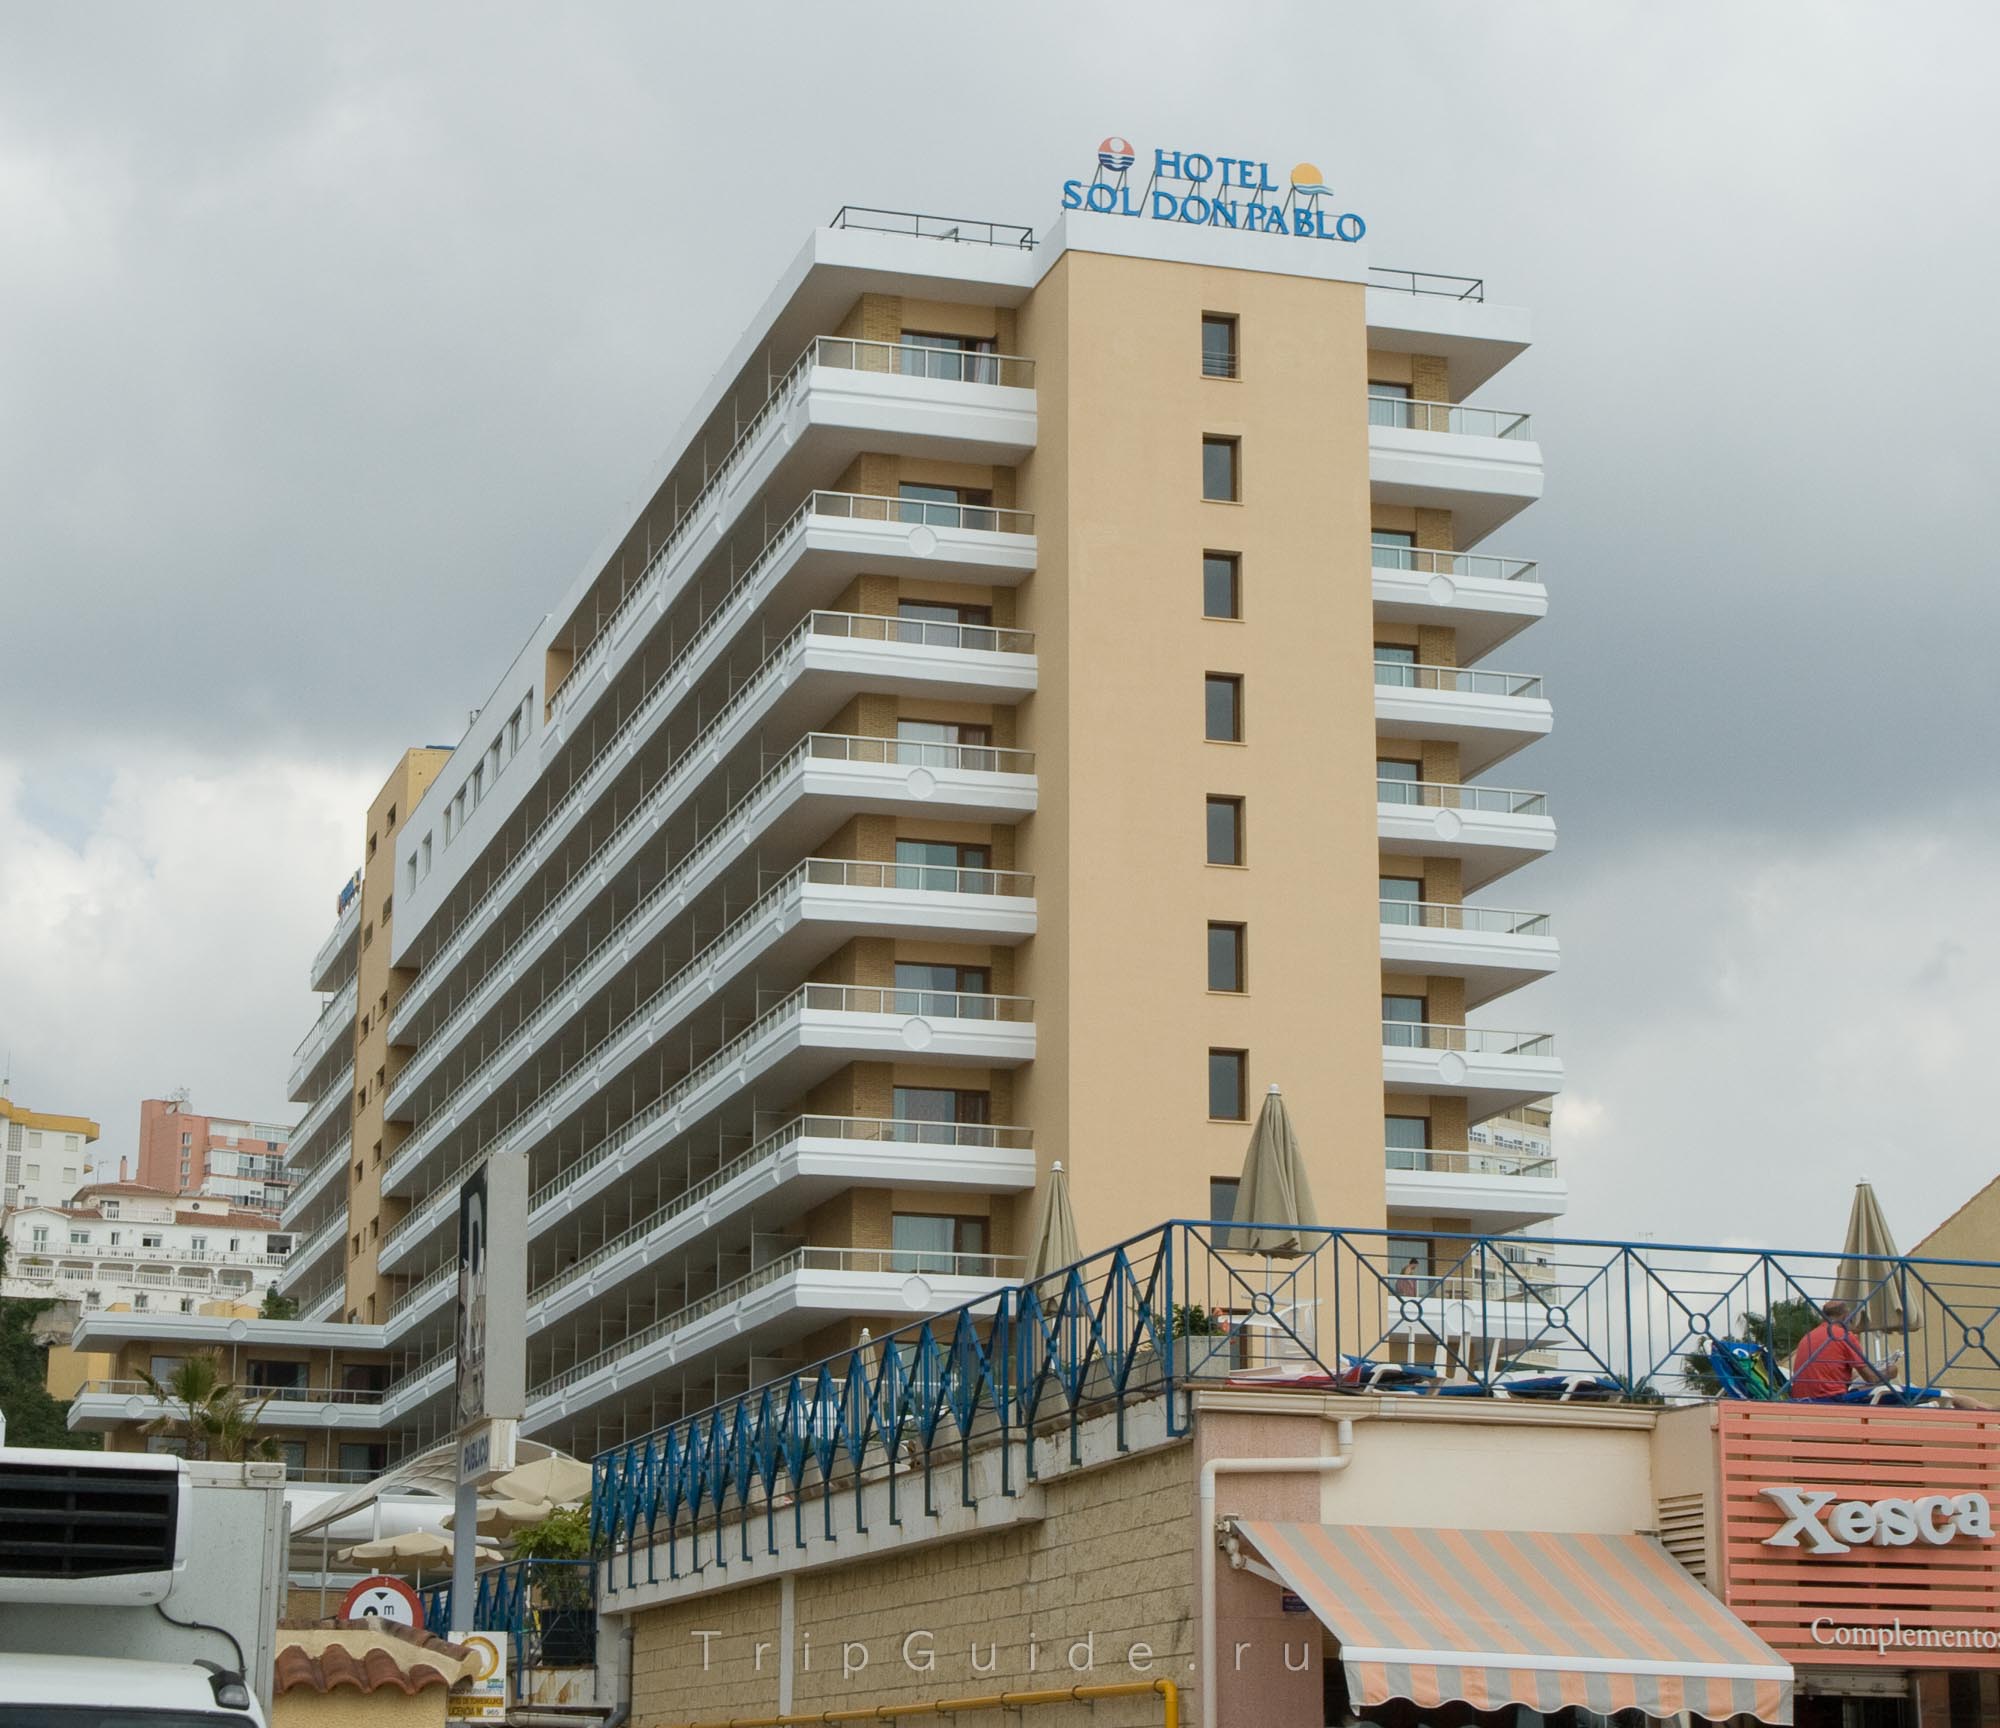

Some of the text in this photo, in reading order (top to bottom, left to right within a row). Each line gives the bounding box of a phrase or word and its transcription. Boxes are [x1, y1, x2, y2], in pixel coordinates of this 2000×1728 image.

[1154, 148, 1279, 192] HOTEL
[1061, 179, 1367, 243] SOL DON PABLO
[1759, 1486, 1996, 1555] Xesca
[1810, 1617, 2000, 1656] Complemento
